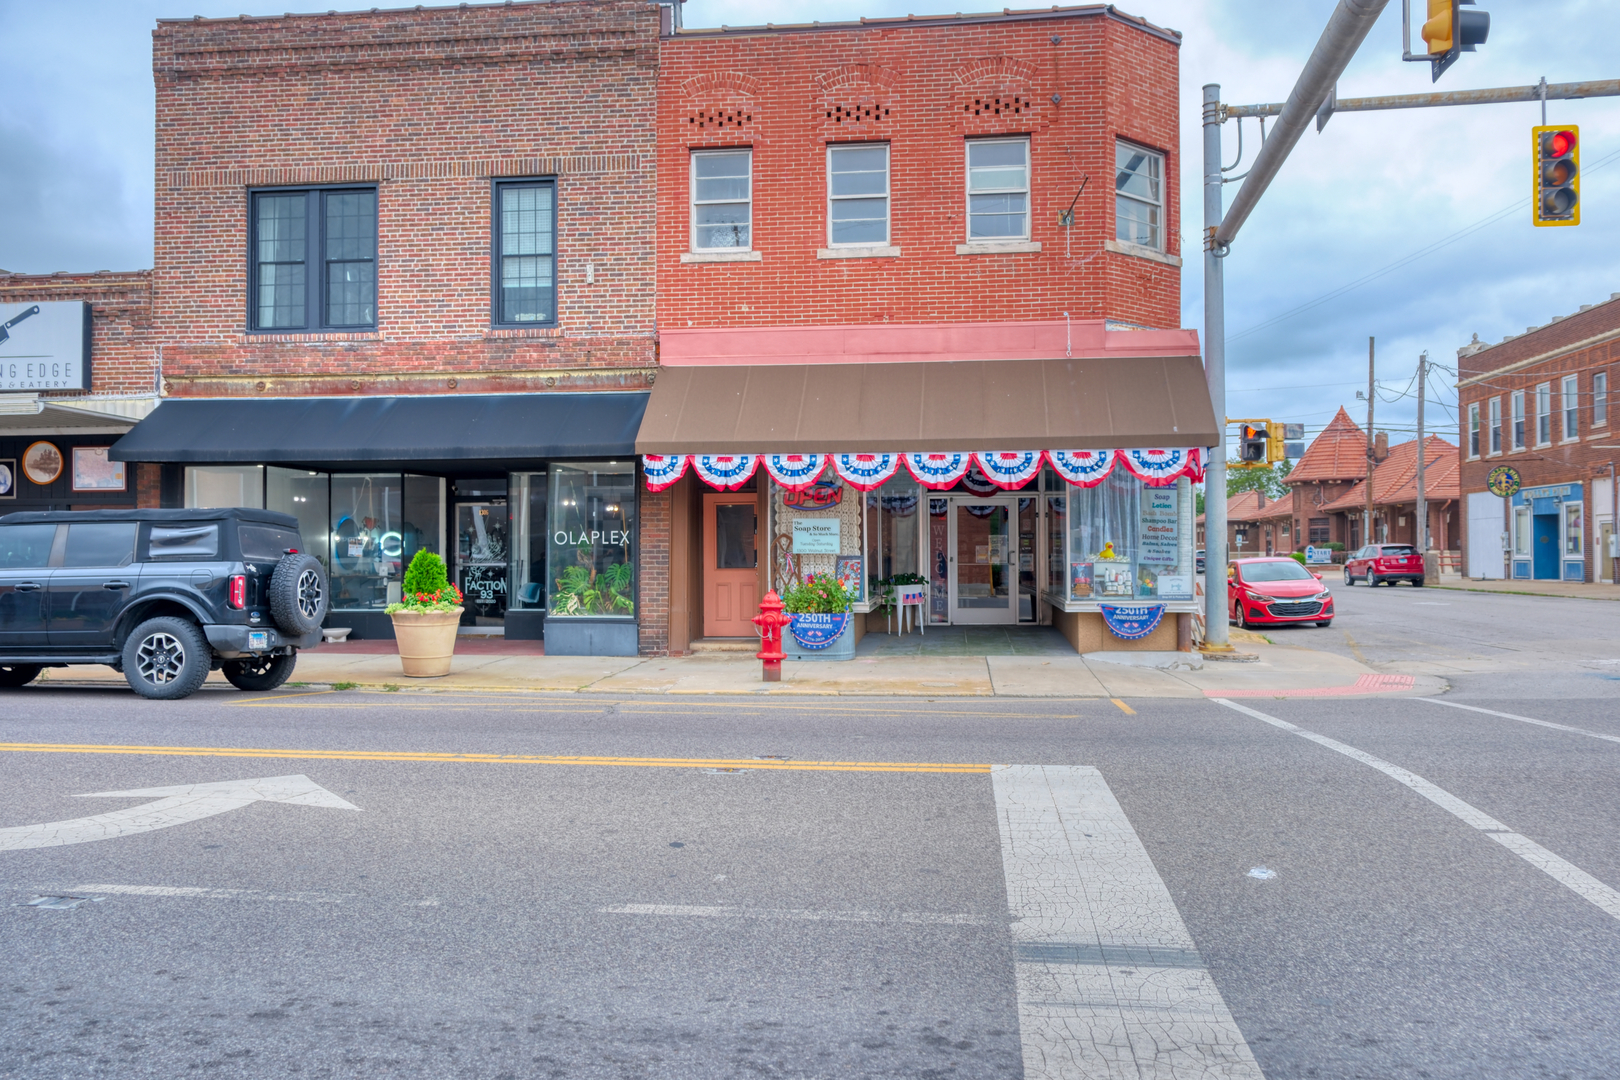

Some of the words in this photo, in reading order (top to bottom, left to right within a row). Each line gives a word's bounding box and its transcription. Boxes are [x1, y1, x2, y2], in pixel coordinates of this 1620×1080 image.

[27, 363, 71, 377] EDGE
[20, 380, 67, 388] EATERY
[783, 486, 843, 506] OPEN
[554, 530, 630, 545] OLAPLEX
[465, 577, 507, 594] FACTION
[480, 590, 493, 599] 93
[799, 613, 831, 622] 250TH
